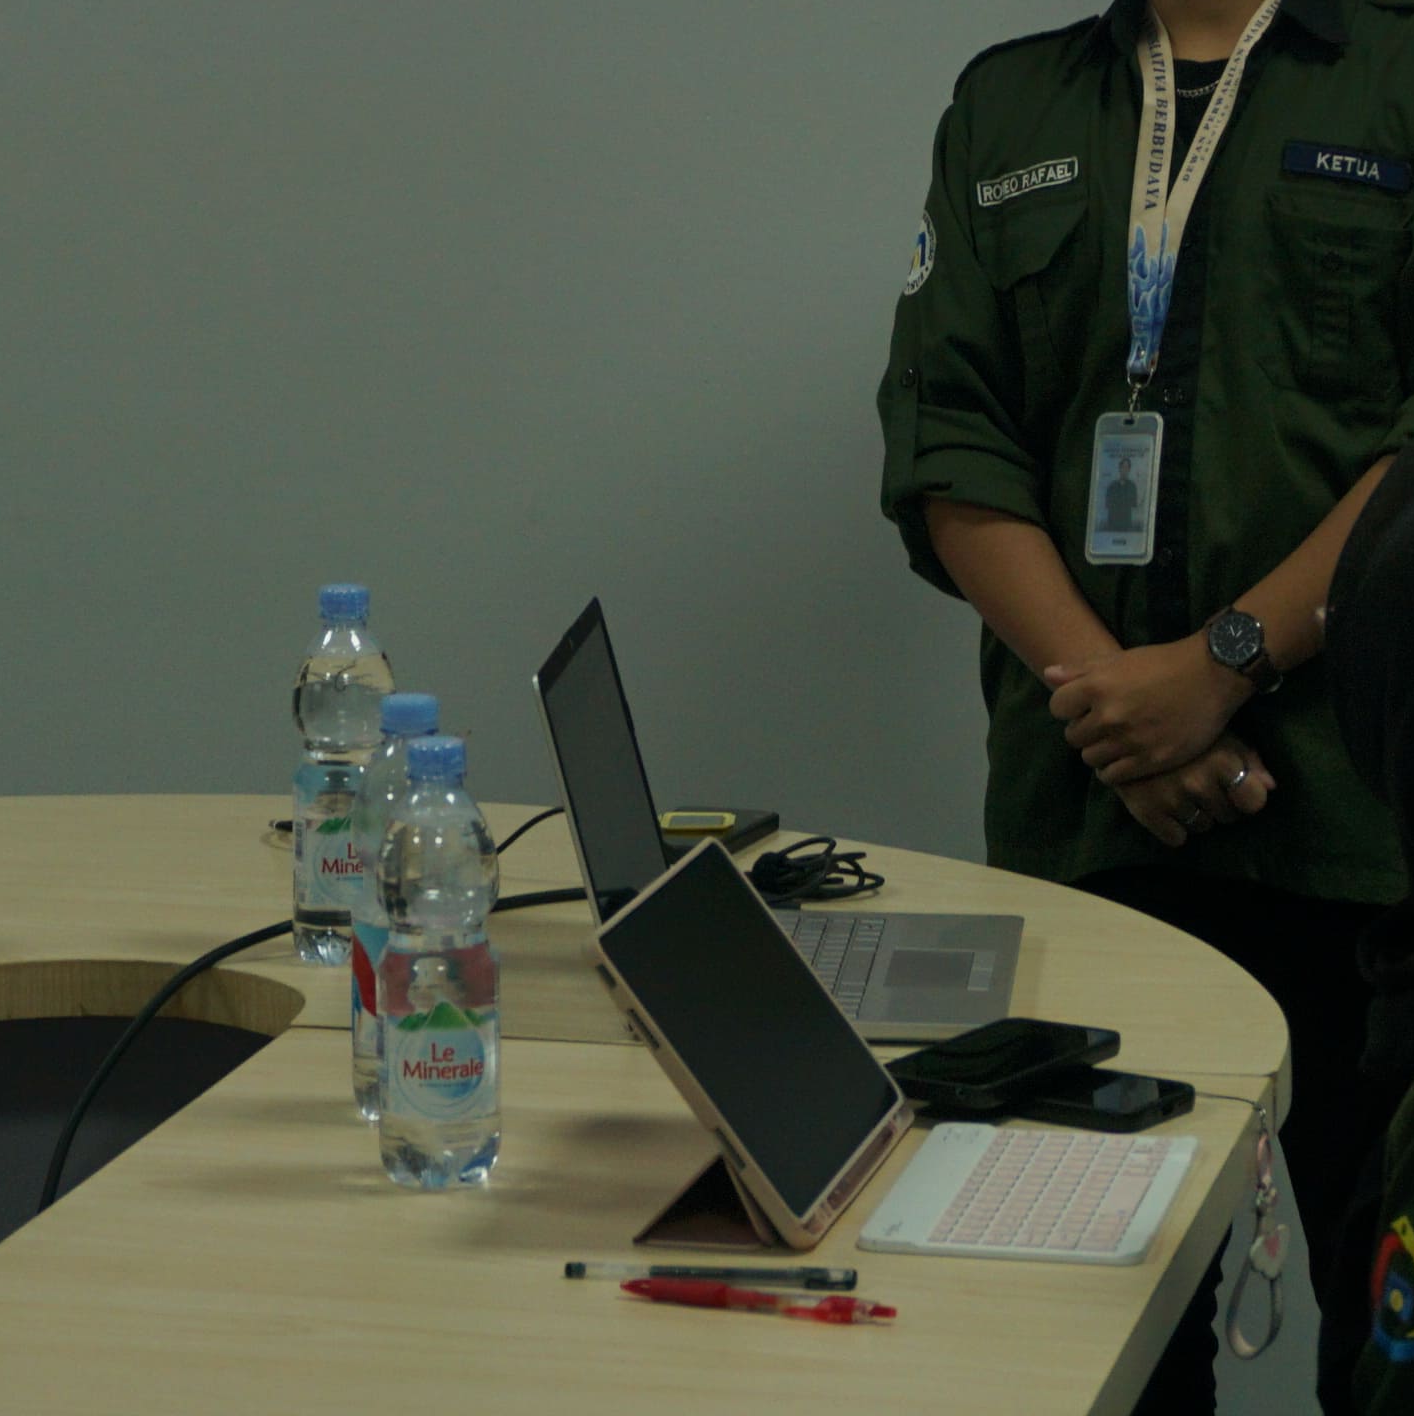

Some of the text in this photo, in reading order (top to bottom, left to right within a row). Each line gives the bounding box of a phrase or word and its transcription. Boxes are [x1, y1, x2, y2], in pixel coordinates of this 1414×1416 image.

[1144, 96, 1169, 211] BERBUDAYA
[1183, 136, 1206, 182] DEWAN
[1316, 151, 1380, 181] KETUA
[1022, 163, 1072, 189] RAFAEL
[322, 857, 363, 875] Mine
[431, 1042, 455, 1063] Le
[403, 1057, 483, 1080] Minerale
